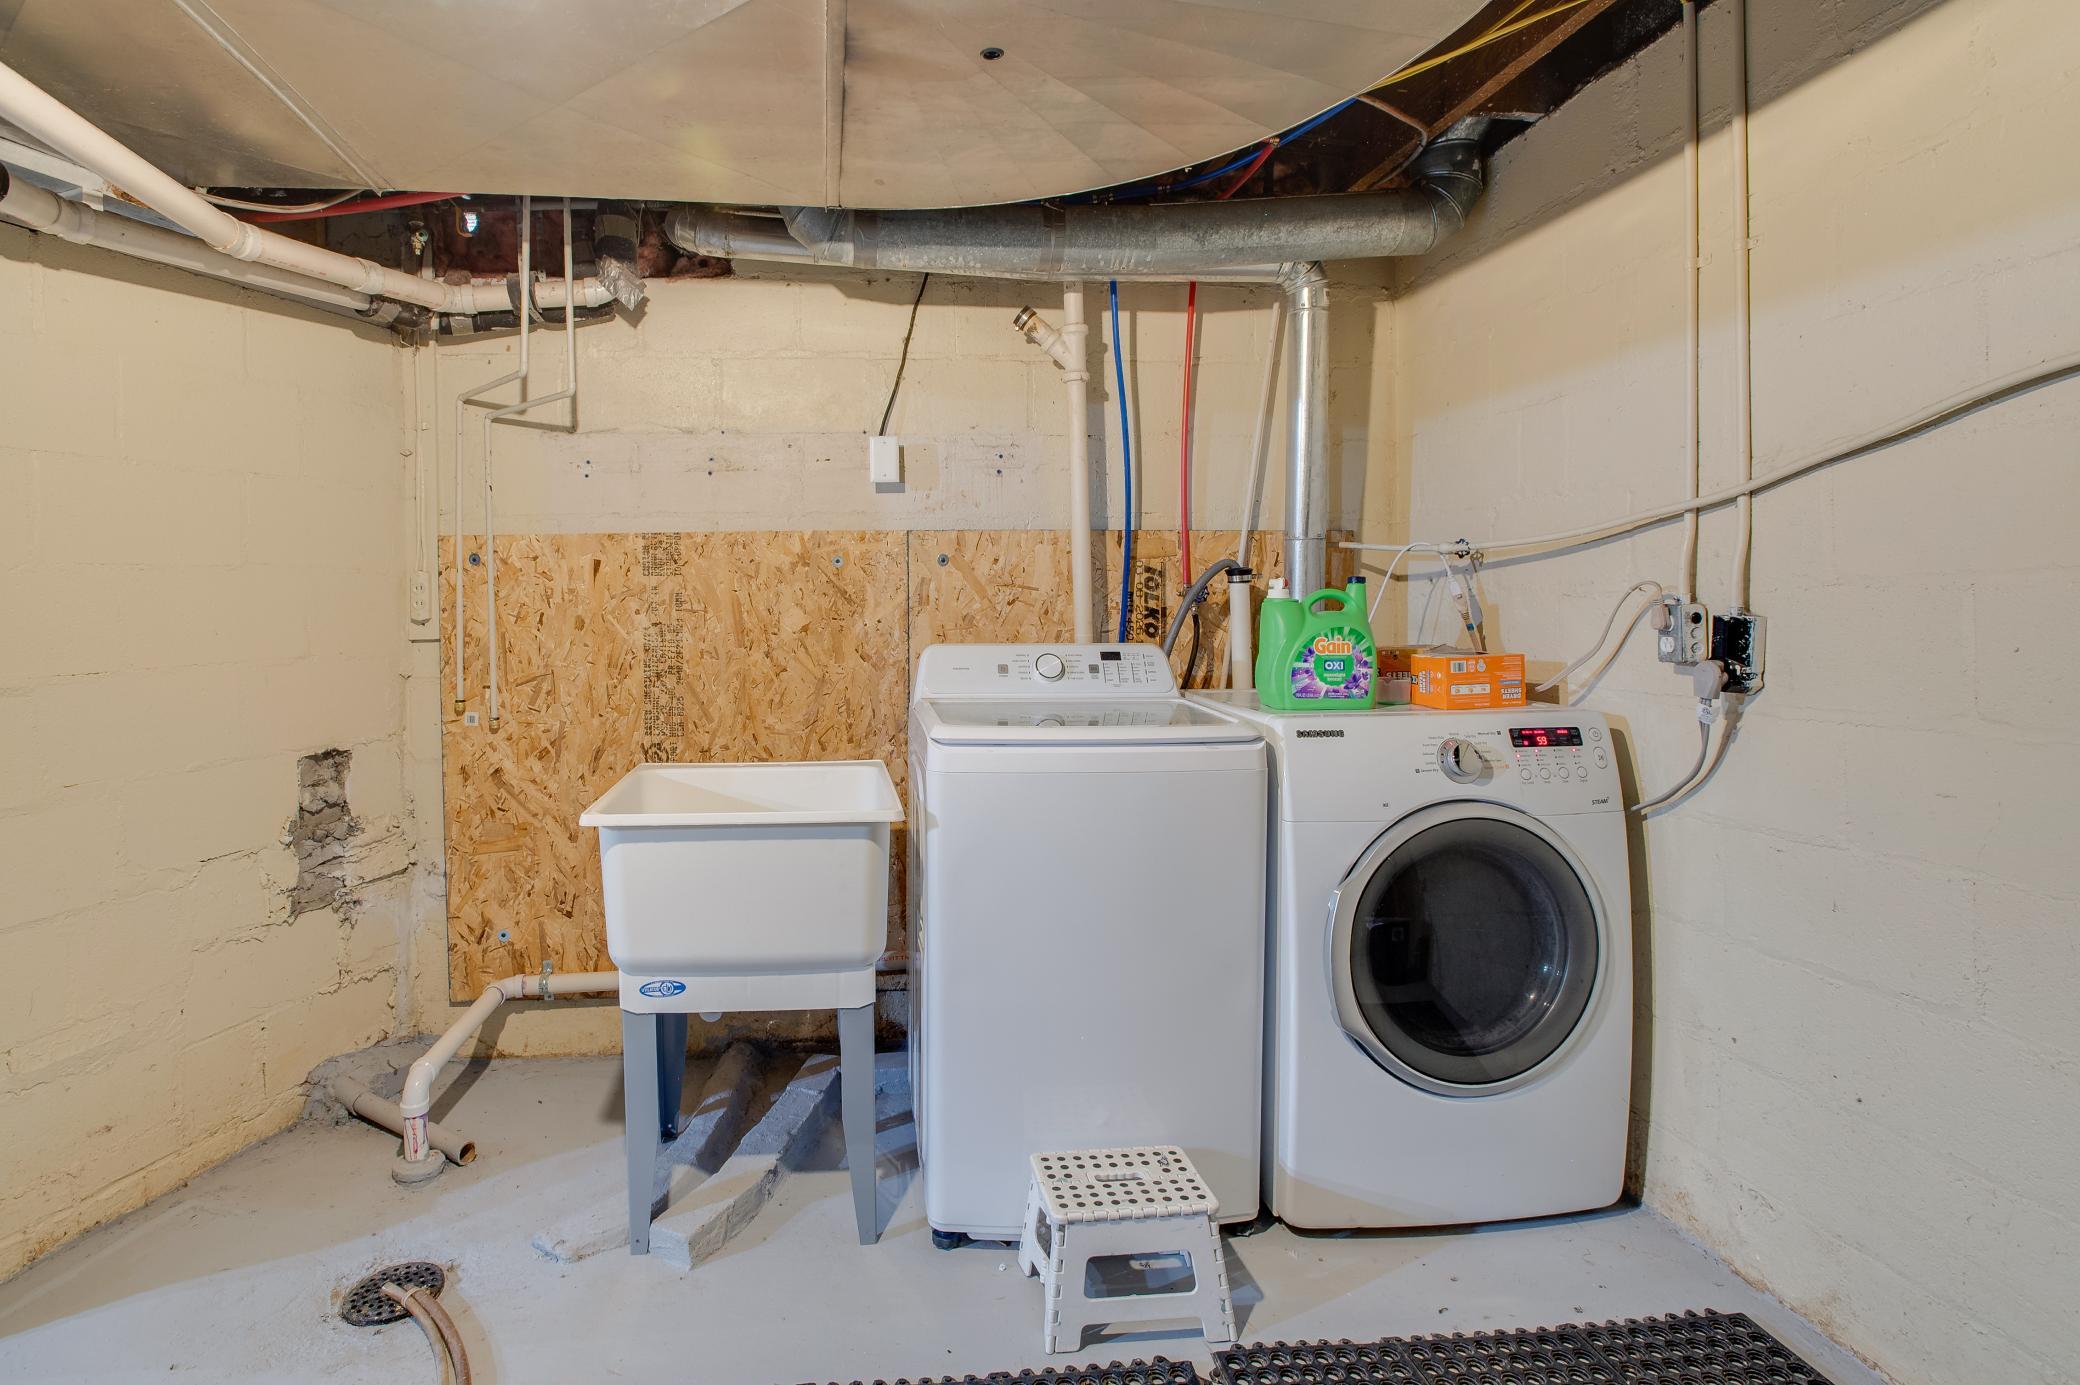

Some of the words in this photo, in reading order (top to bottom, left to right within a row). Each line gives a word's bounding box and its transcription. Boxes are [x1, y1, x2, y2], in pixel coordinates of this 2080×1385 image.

[1144, 565, 1161, 638] TOLKO
[1314, 635, 1352, 656] Gain
[1324, 660, 1344, 670] OXI
[1296, 729, 1345, 739] SAMSUNG
[1536, 736, 1548, 746] 59
[1591, 798, 1609, 806] STEAM
